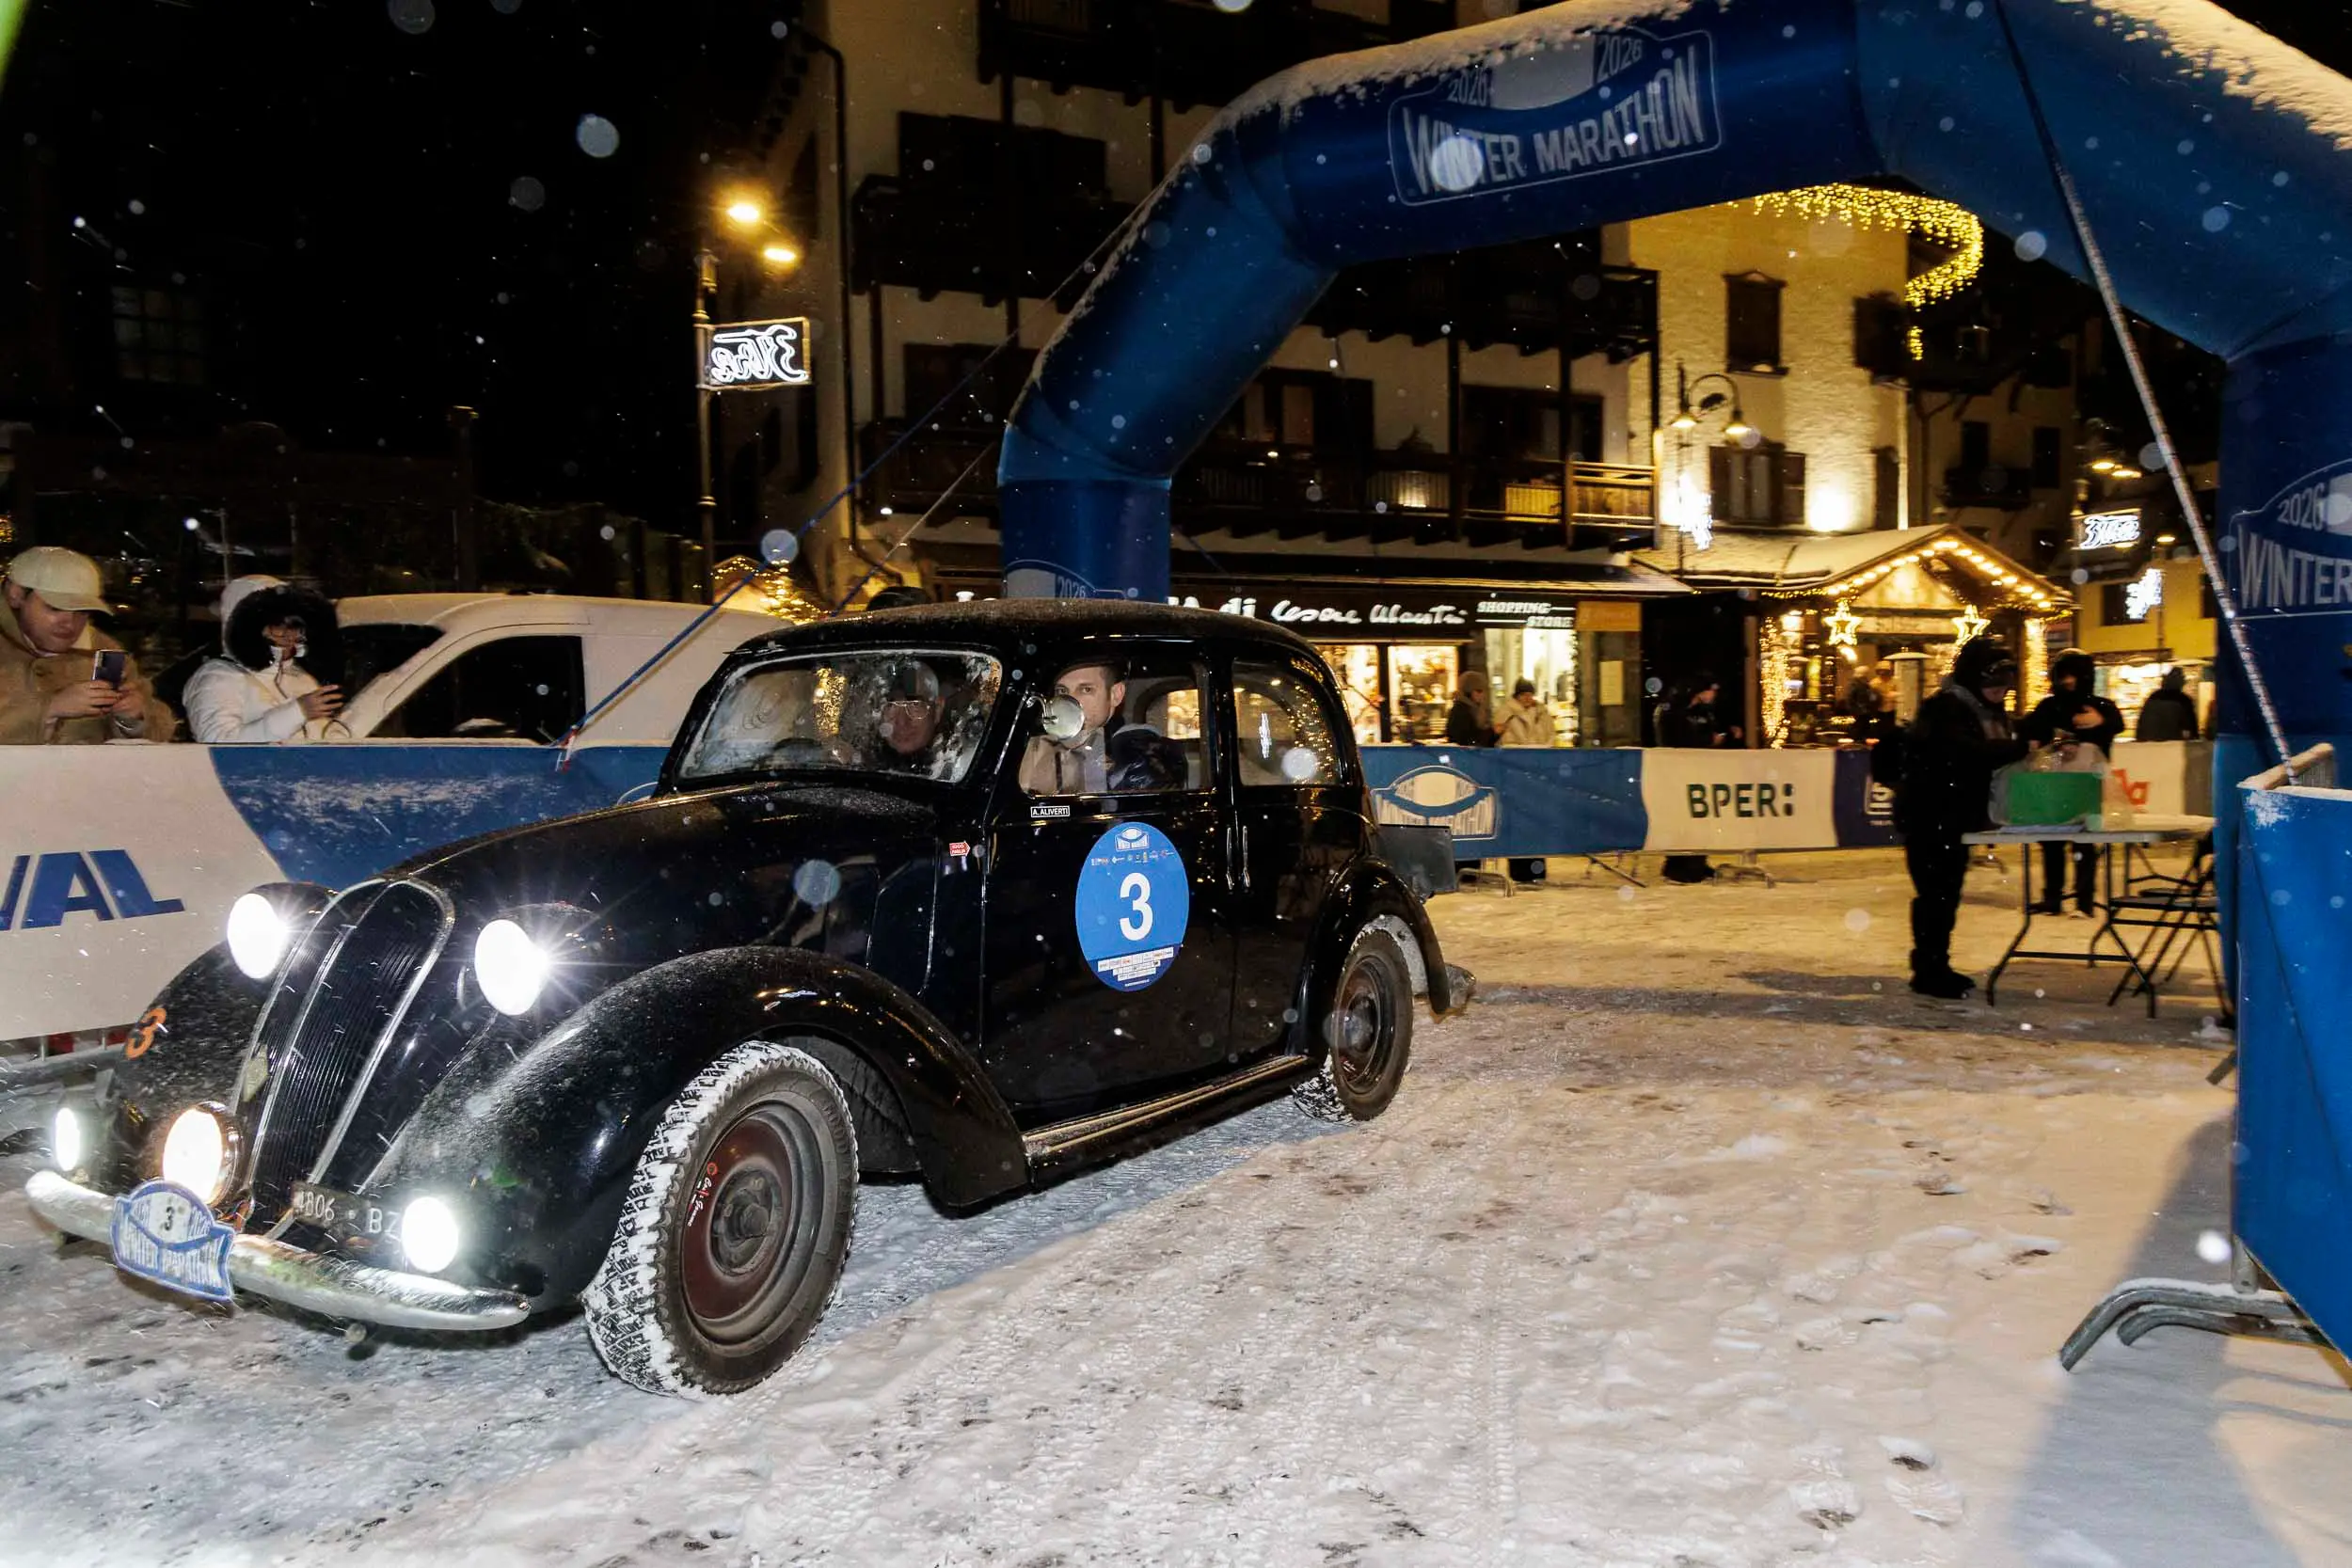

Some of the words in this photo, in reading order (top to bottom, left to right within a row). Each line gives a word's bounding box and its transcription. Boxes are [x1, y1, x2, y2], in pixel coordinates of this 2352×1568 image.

[1597, 35, 1644, 82] 2026
[1403, 105, 1527, 196] WINTER
[1534, 44, 1705, 176] MARATHON
[2277, 483, 2326, 531] 2026
[2237, 523, 2352, 610] WINTER
[1476, 600, 1552, 614] SHOPPING
[1526, 615, 1575, 627] STORE
[1040, 807, 1069, 816] ALIVERTI
[1119, 872, 1153, 942] 3
[124, 1007, 167, 1059] 3
[162, 1206, 175, 1231] 3
